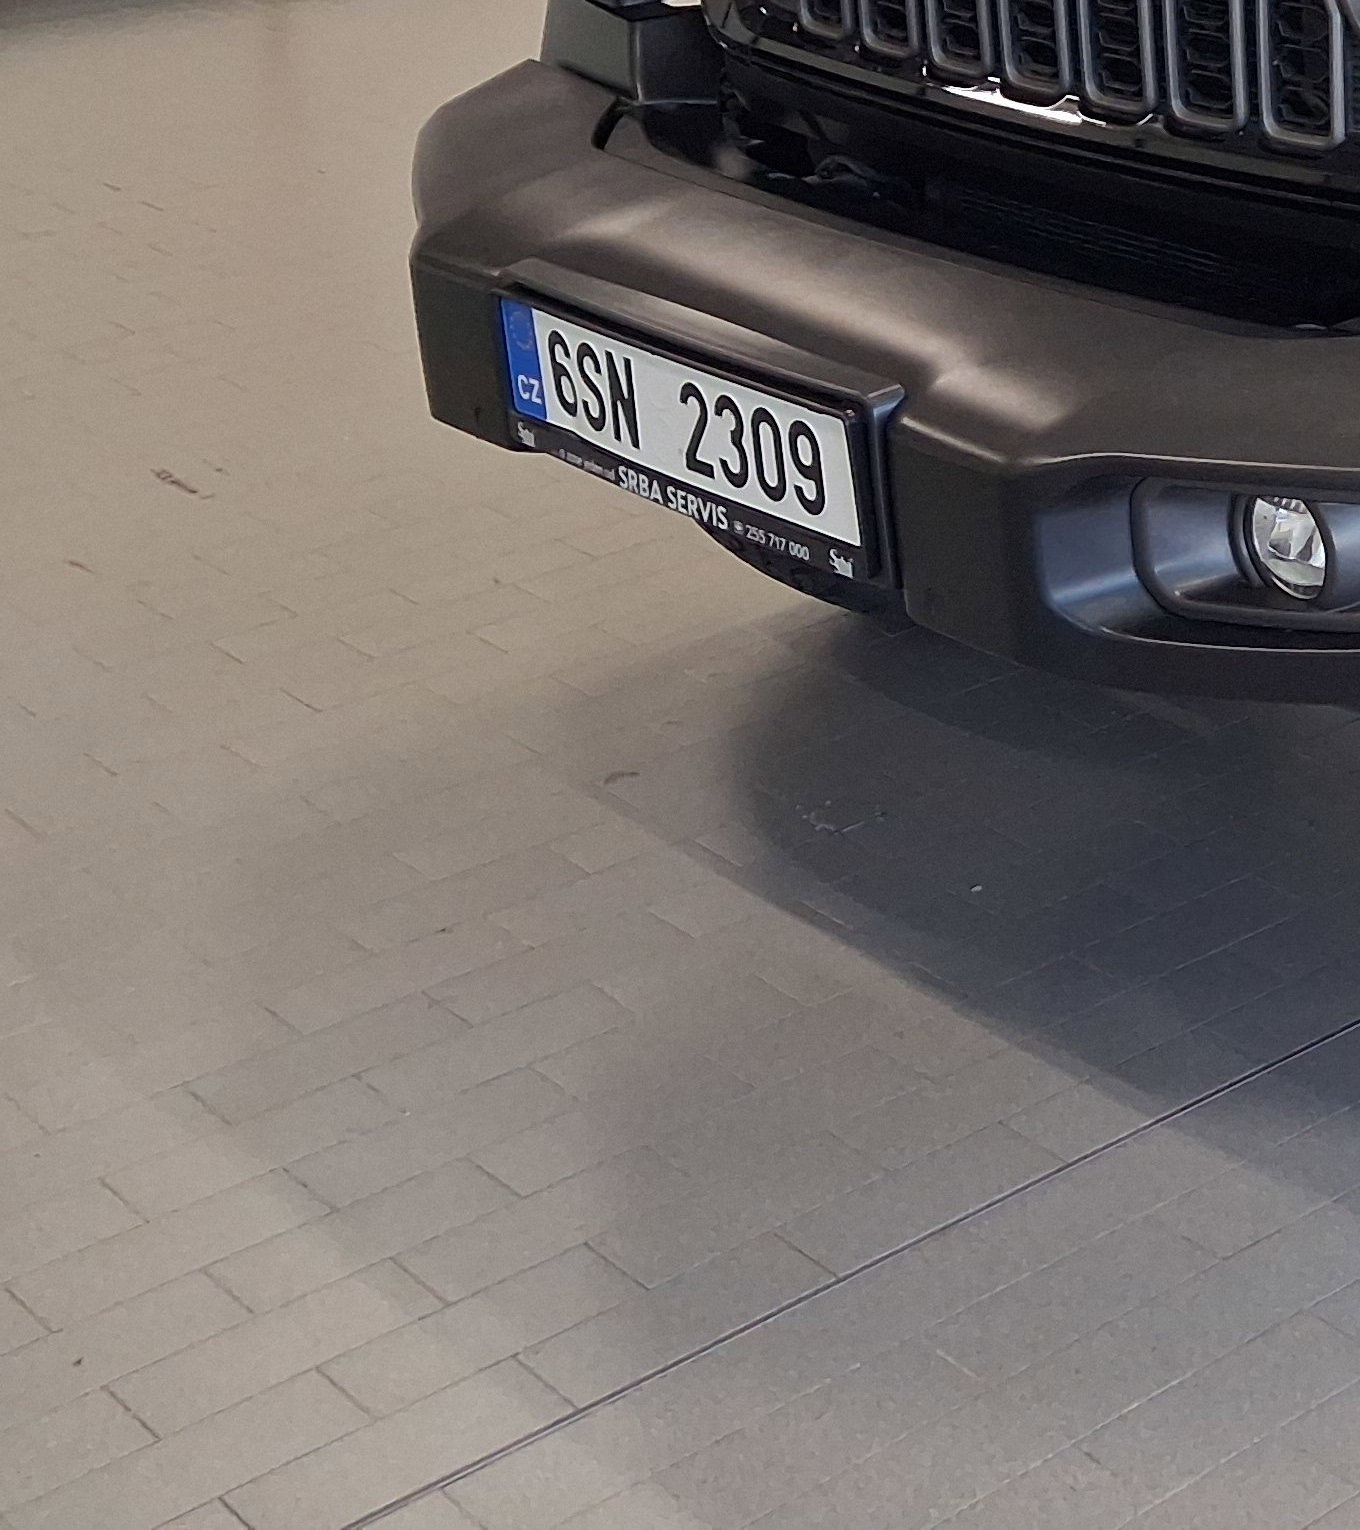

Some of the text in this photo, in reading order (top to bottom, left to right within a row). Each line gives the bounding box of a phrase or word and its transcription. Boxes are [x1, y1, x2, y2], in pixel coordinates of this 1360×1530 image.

[517, 373, 543, 405] CZ
[546, 329, 826, 516] 6SN 2309
[618, 465, 663, 504] SRBA
[666, 486, 729, 531] SERVIS
